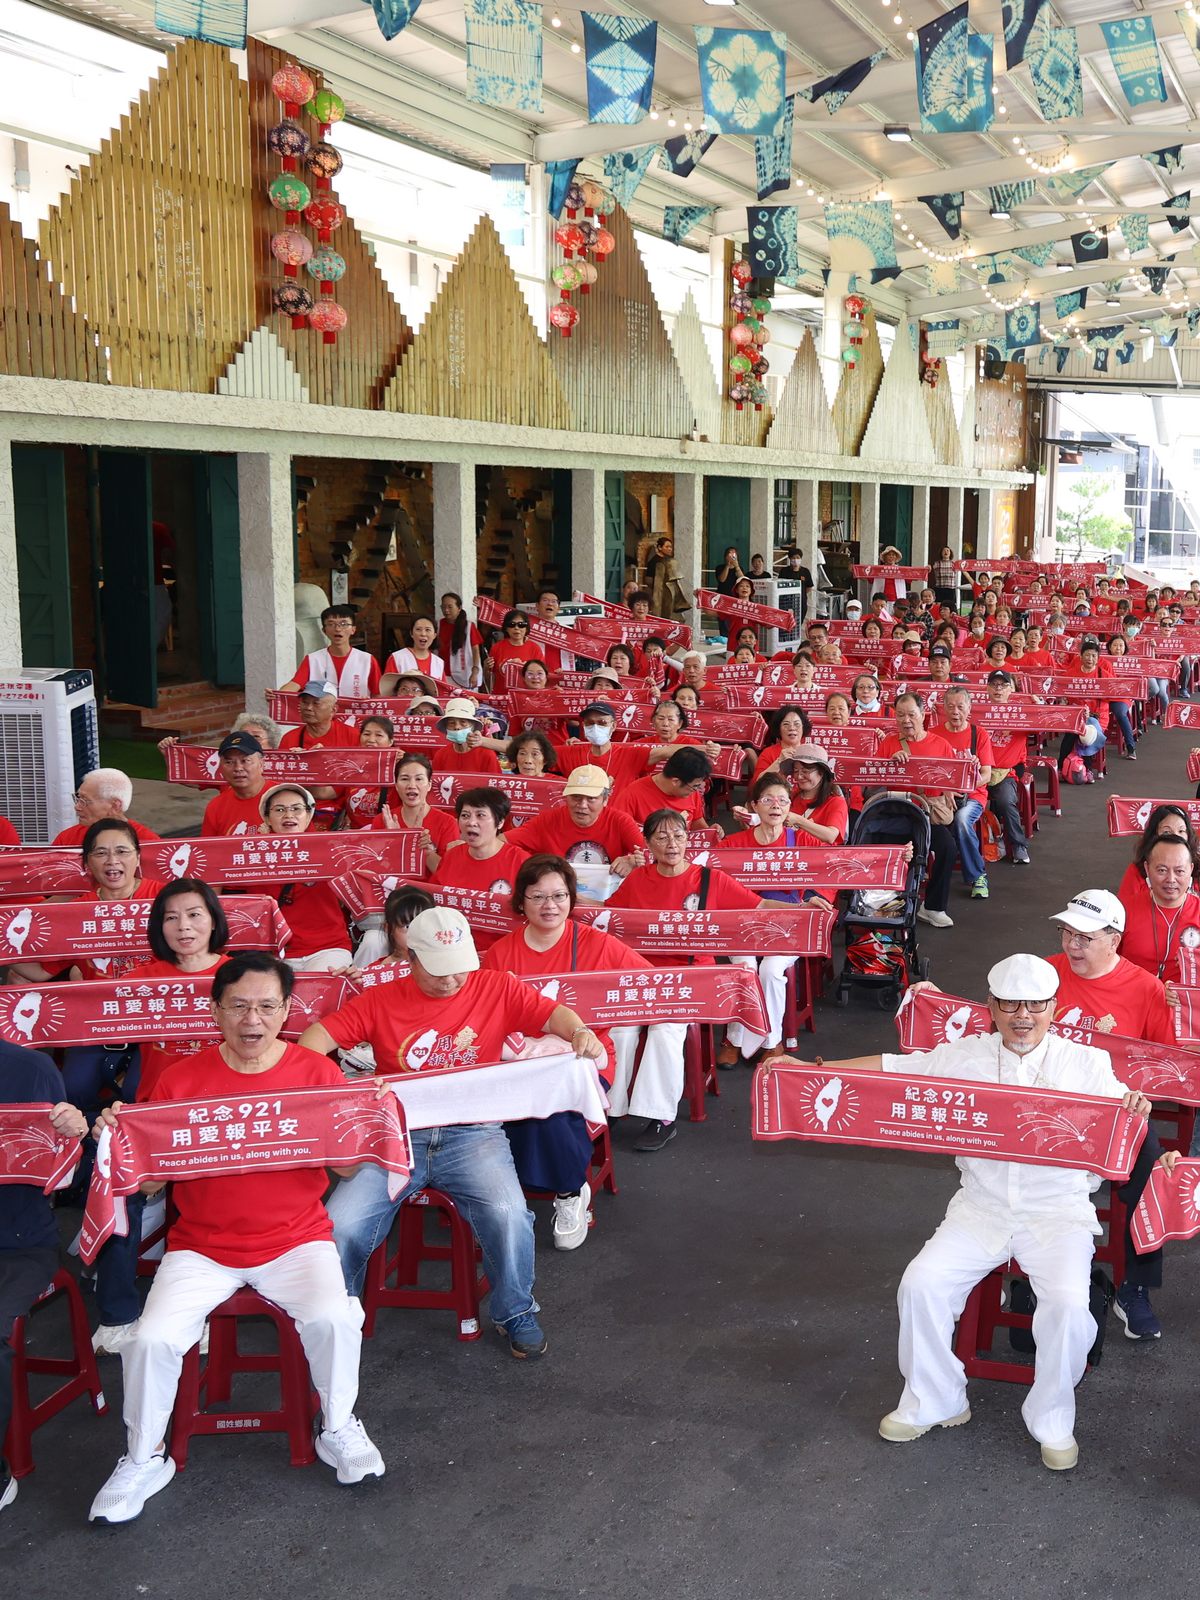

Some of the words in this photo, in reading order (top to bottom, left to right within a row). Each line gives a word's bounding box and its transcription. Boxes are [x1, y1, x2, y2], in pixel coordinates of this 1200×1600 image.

[393, 725, 433, 735] 愛報平安
[263, 761, 309, 771] 愛報平安
[488, 779, 528, 790] 紀念921
[242, 838, 299, 851] 紀念921
[232, 851, 310, 866] 用愛報平安
[752, 850, 800, 861] 紀念921
[742, 861, 808, 872] 用愛報平安
[94, 903, 151, 917] 紀念92
[433, 893, 502, 913] 用愛報平安
[658, 911, 712, 923] 紀念921
[82, 918, 150, 934] 用愛報平
[647, 923, 720, 936] 用愛報平安
[362, 967, 411, 988] 愛報平
[619, 973, 683, 987] 紀念921
[115, 983, 196, 998] 紀念921
[606, 986, 693, 1003] 用愛報平安
[102, 997, 210, 1016] 用愛報平安
[654, 1008, 671, 1017] along
[672, 1007, 684, 1015] with
[92, 1025, 115, 1033] Peace
[117, 1024, 142, 1032] abides
[167, 1022, 188, 1031] along
[189, 1021, 205, 1029] with
[904, 1086, 976, 1107] 紀念921
[188, 1100, 283, 1124] 紀念921
[891, 1102, 989, 1128] 用愛報平安
[171, 1118, 299, 1147] 用愛報平安
[880, 1128, 901, 1137] Peace
[902, 1129, 925, 1139] abides
[926, 1132, 933, 1140] in
[934, 1134, 945, 1143] us,
[946, 1134, 965, 1145] along
[966, 1136, 981, 1145] with
[982, 1139, 998, 1148] you.
[159, 1158, 186, 1167] Peace
[188, 1155, 217, 1165] abides
[219, 1154, 228, 1162] in
[229, 1154, 243, 1162] us,
[245, 1150, 268, 1161] along
[271, 1149, 288, 1157] with
[291, 1148, 311, 1157] you.
